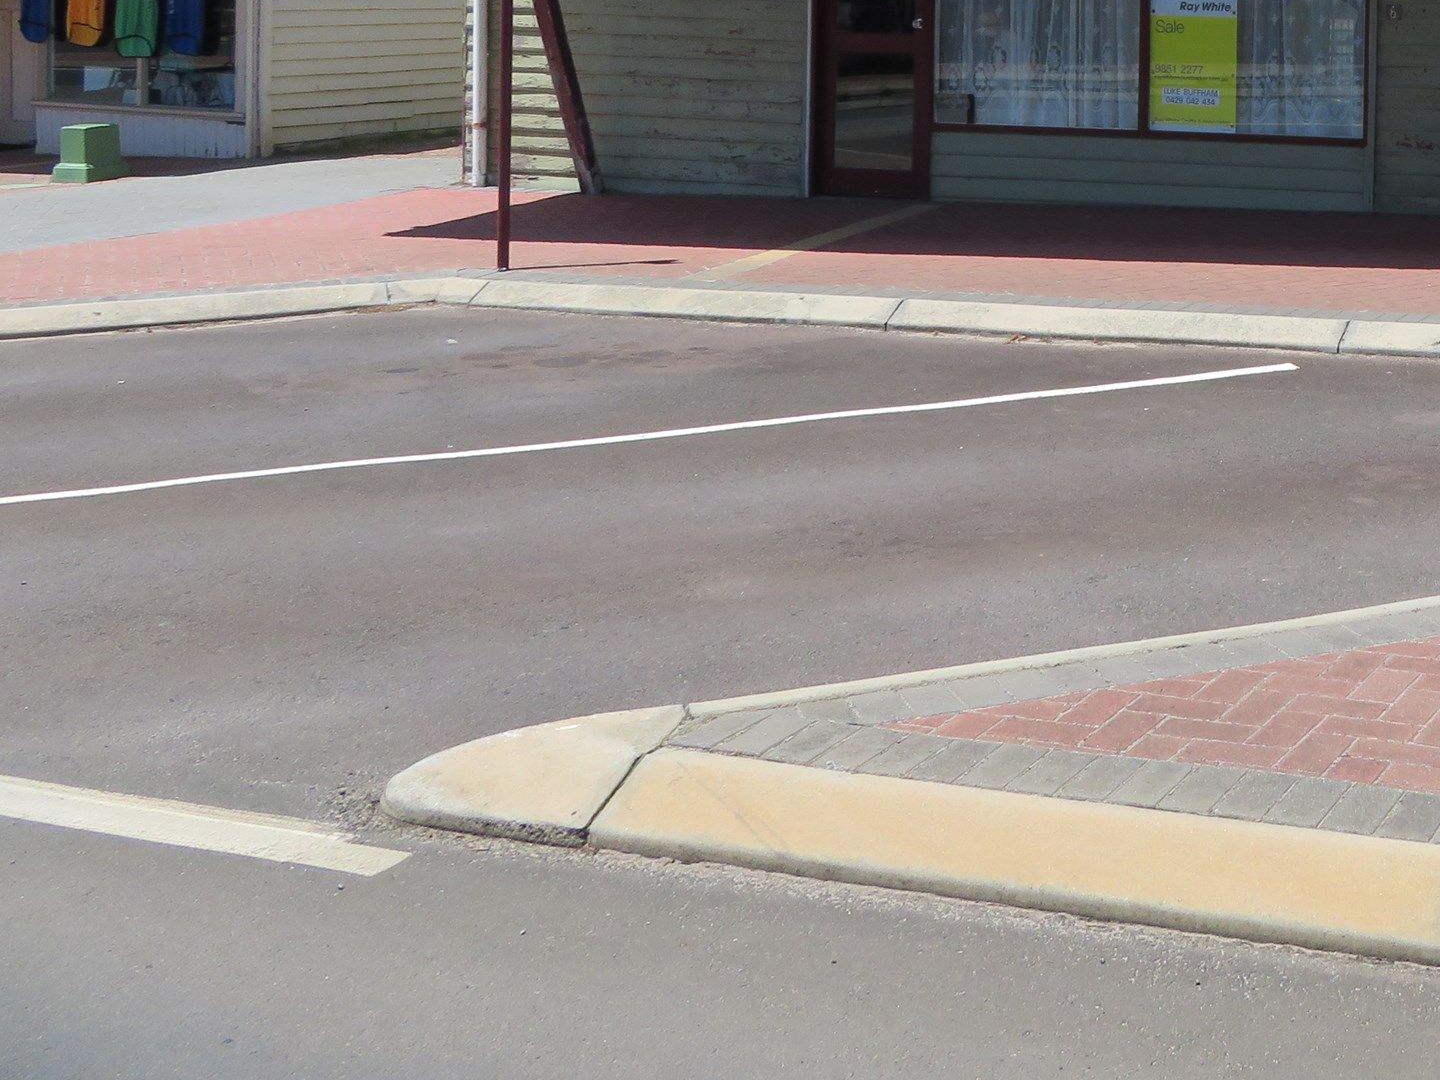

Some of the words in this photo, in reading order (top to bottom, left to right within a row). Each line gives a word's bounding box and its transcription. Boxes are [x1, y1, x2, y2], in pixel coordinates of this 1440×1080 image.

[1179, 1, 1200, 13] Ray
[1202, 2, 1232, 12] White
[1155, 19, 1185, 34] Sale
[1154, 64, 1177, 73] 9851
[1180, 64, 1204, 74] 2277
[1163, 87, 1181, 96] LUKE
